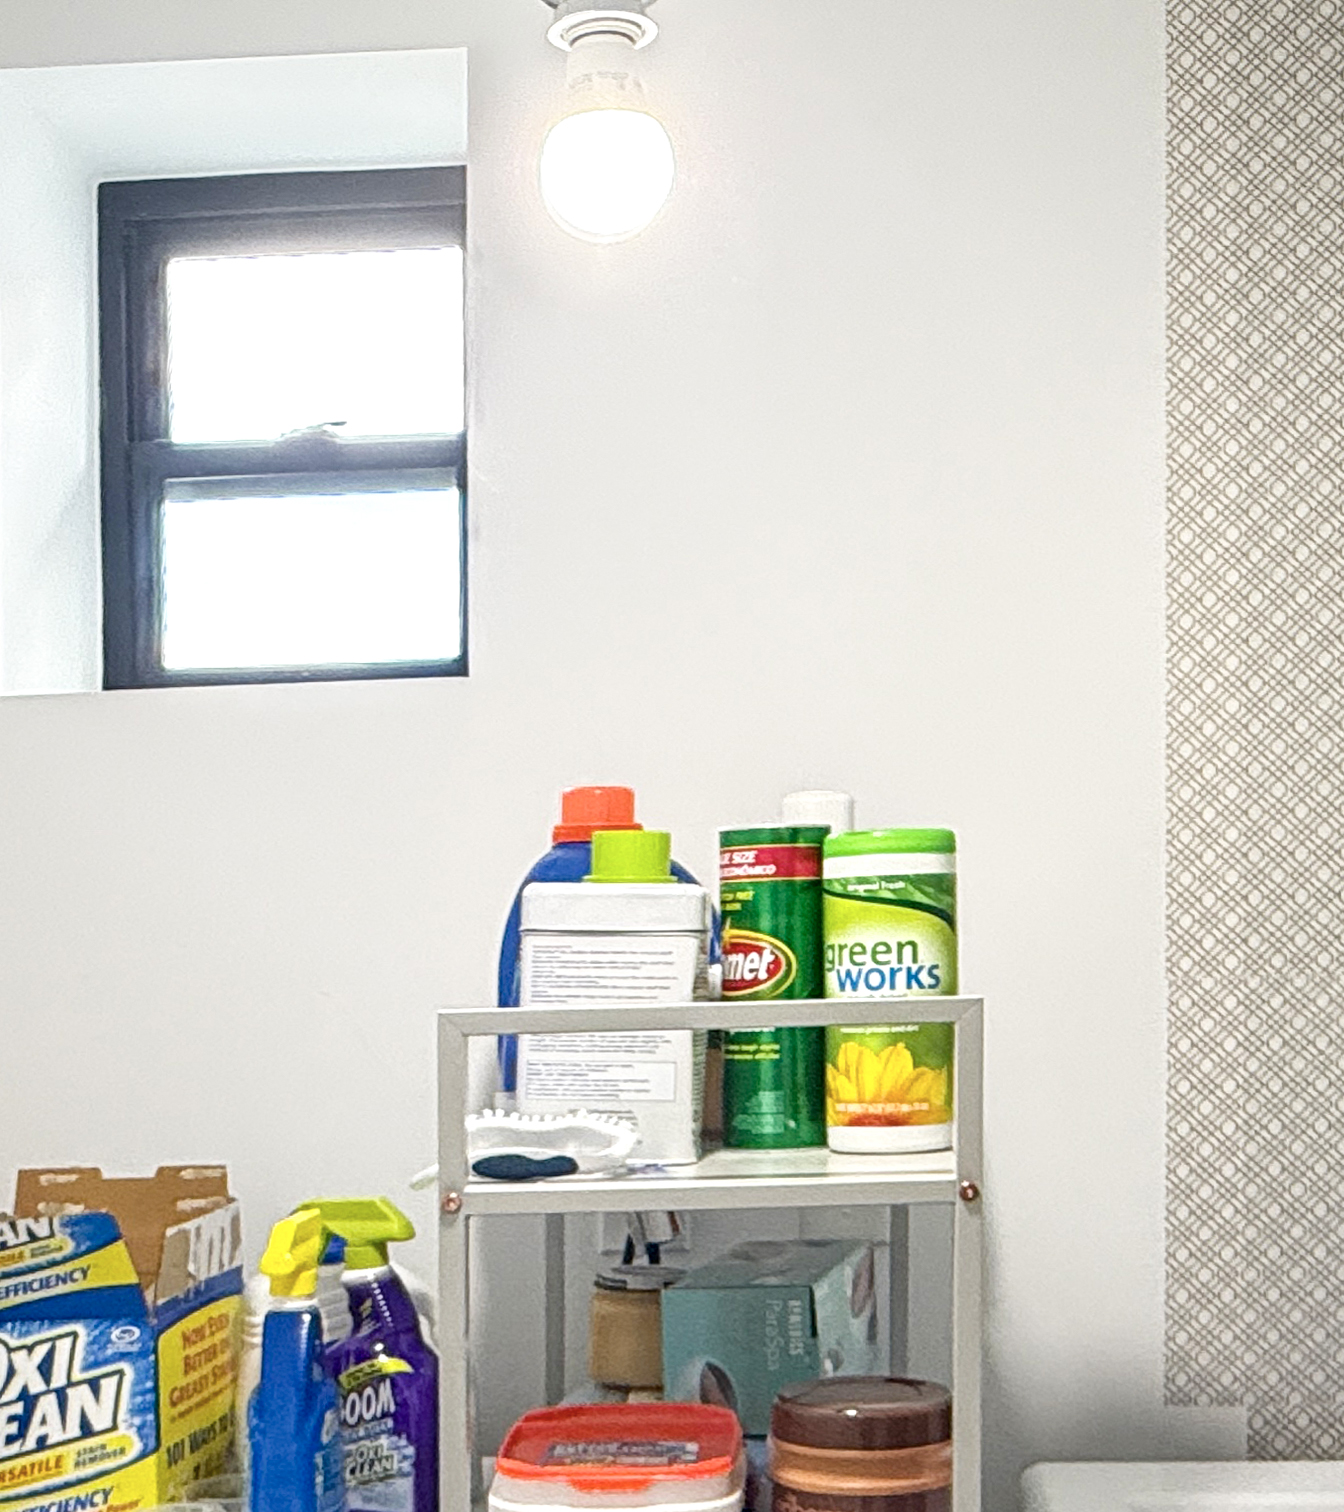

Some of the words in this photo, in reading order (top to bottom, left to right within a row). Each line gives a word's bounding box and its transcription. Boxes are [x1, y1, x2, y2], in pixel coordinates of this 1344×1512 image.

[722, 948, 775, 980] met
[825, 940, 919, 972] green
[836, 964, 941, 993] works
[340, 1377, 396, 1426] OOM
